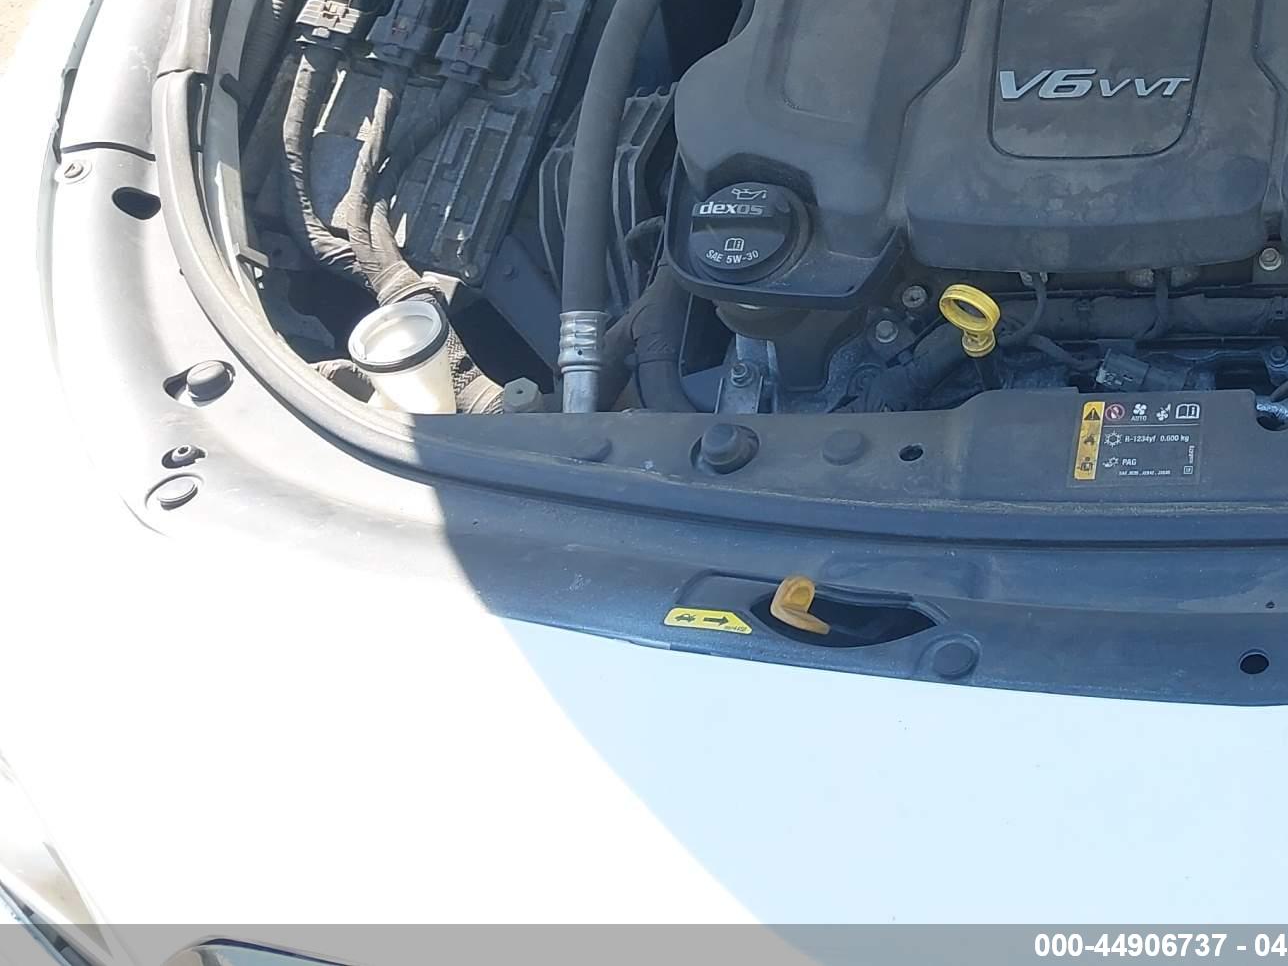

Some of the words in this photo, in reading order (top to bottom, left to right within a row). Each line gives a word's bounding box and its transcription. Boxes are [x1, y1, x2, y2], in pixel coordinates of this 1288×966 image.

[1000, 68, 1097, 99] V6
[1100, 77, 1191, 97] VVT
[699, 201, 765, 215] dexos
[706, 249, 723, 263] SAE
[726, 249, 759, 264] 5W-30
[1124, 435, 1157, 443] R-1234yf
[1180, 434, 1190, 442] kg
[1122, 458, 1137, 466] PAG
